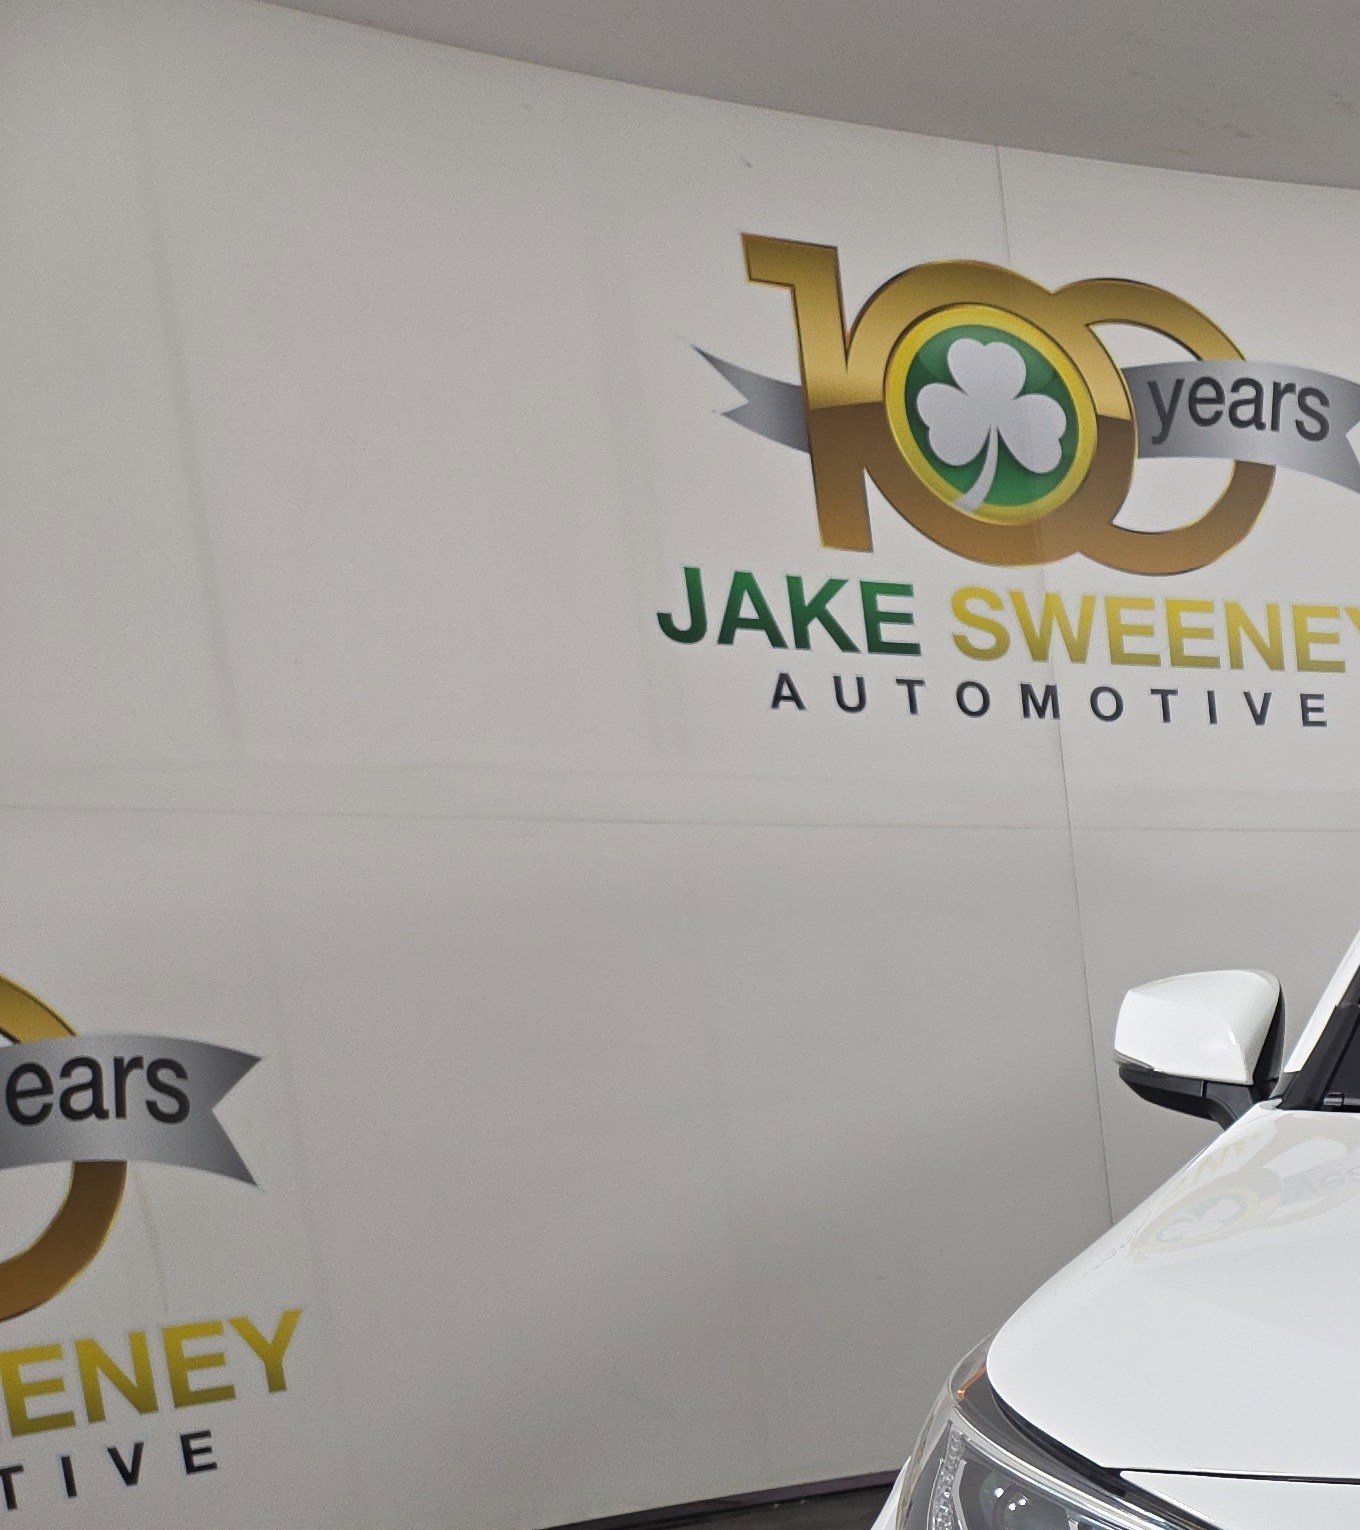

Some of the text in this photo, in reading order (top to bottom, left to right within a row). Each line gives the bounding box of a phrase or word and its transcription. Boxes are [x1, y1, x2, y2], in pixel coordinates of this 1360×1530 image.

[741, 233, 1331, 577] 100 years
[657, 566, 922, 657] JAKE
[770, 672, 1329, 728] AUTOMOTIVE
